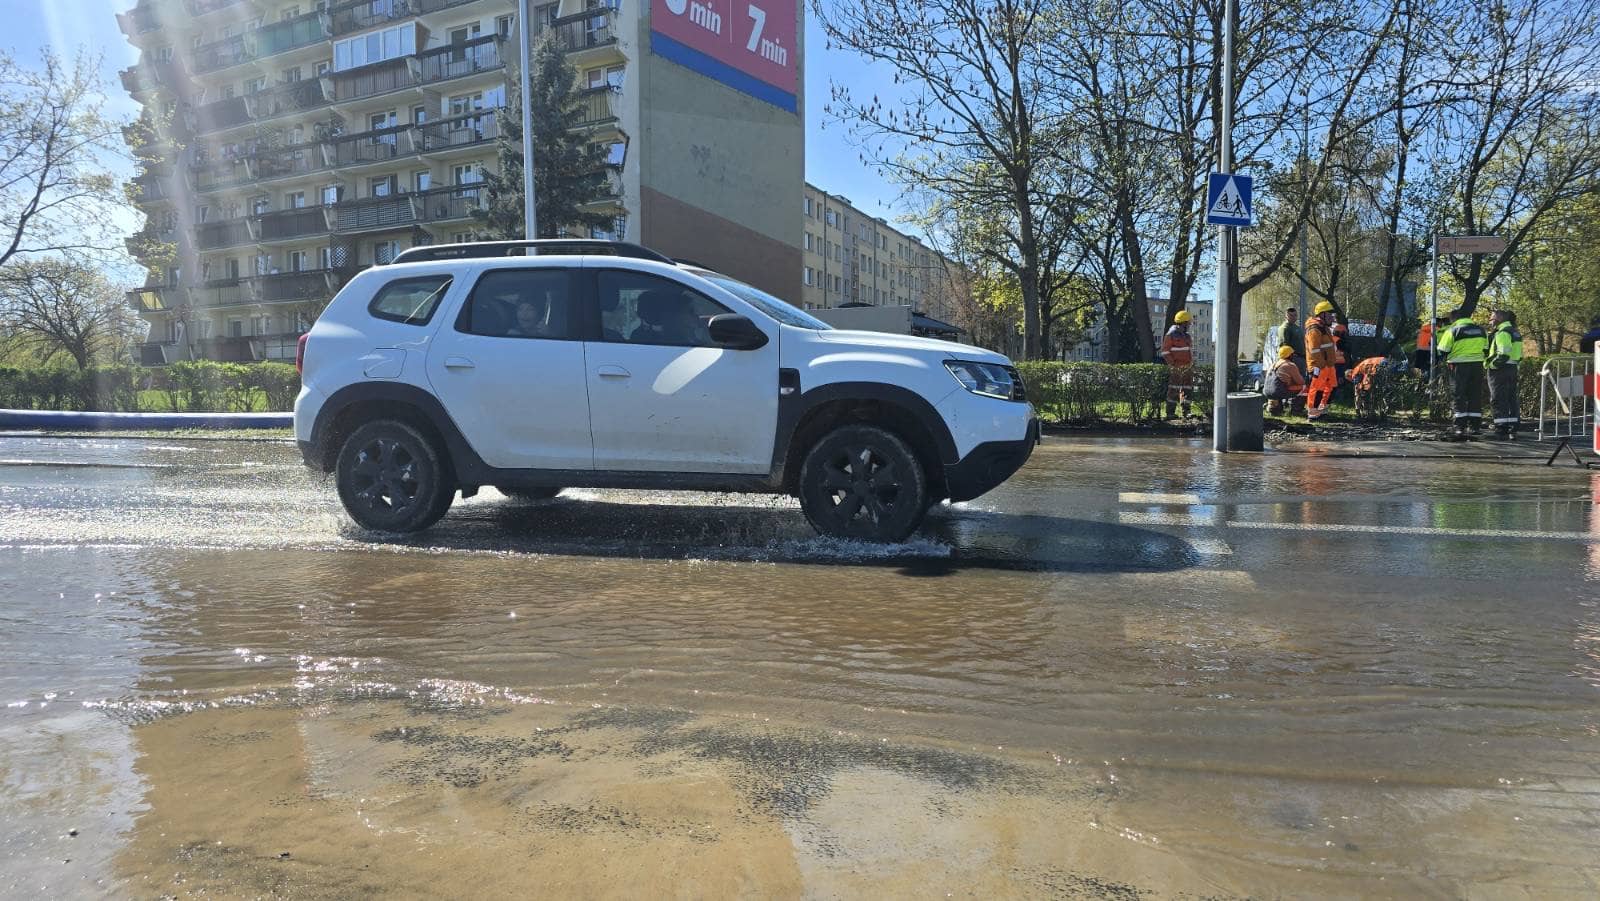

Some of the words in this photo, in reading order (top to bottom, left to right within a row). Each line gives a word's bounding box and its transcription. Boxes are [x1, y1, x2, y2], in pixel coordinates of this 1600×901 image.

[690, 1, 721, 35] min
[746, 4, 766, 52] 7
[761, 38, 787, 67] min
